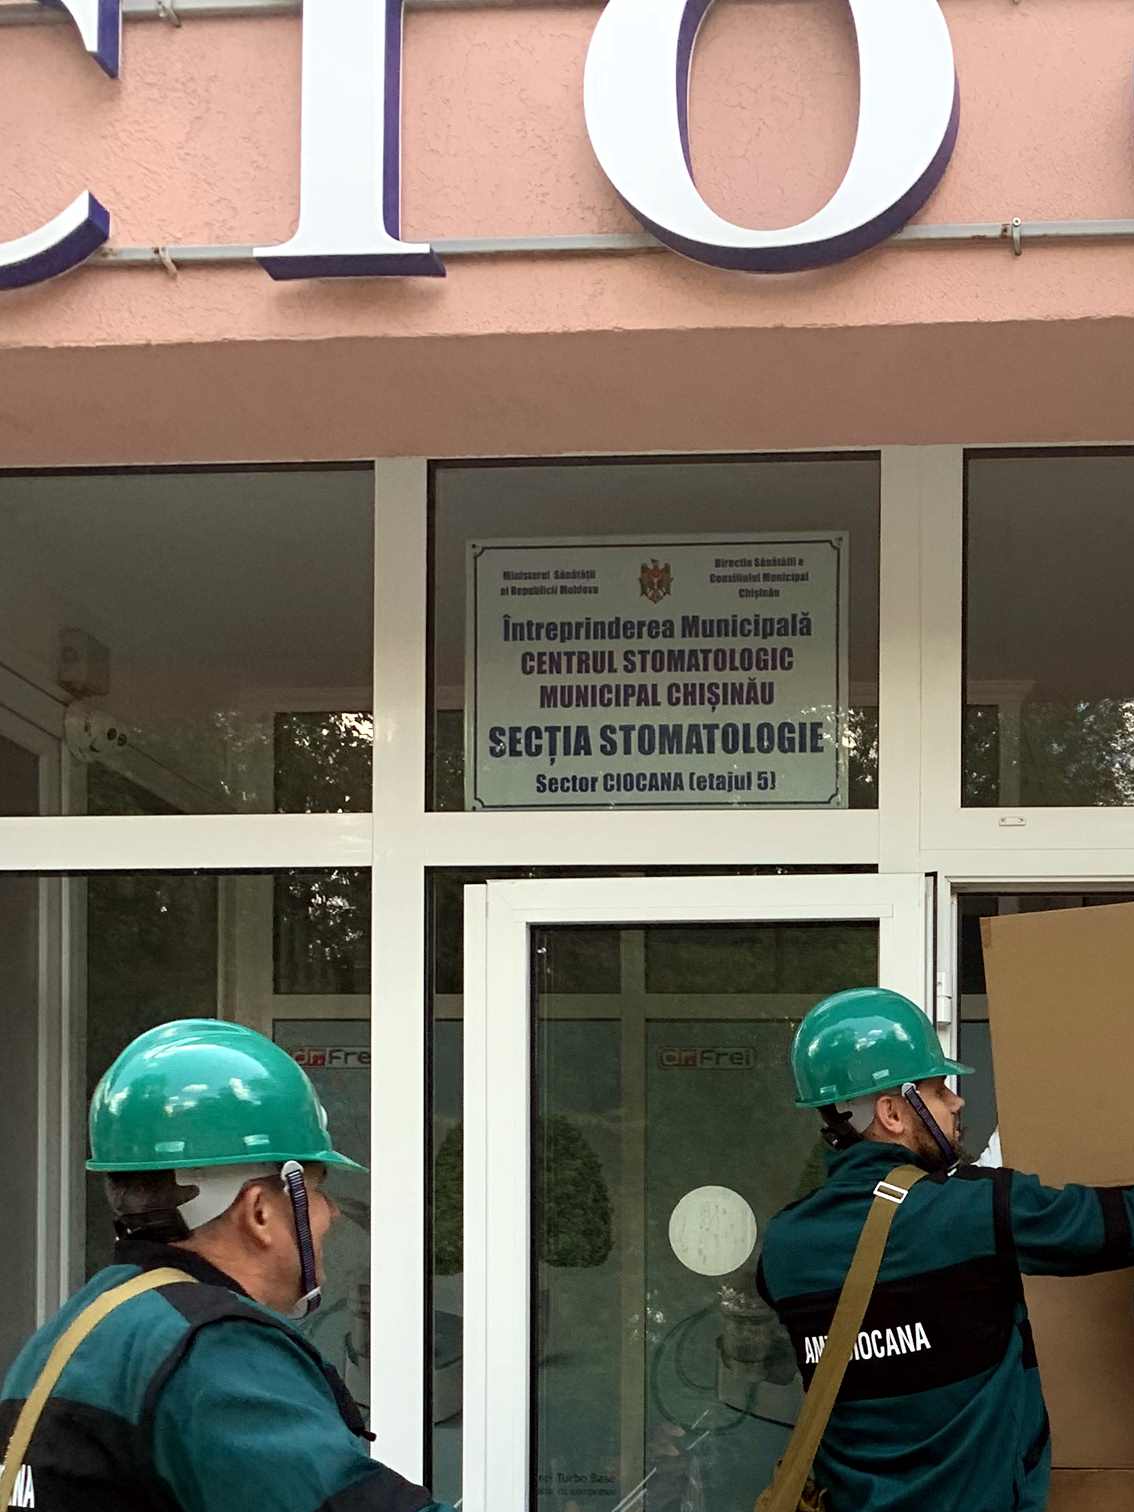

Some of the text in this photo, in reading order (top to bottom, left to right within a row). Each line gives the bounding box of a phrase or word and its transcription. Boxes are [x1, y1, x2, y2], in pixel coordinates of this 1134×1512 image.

[502, 611, 812, 643] Întreprinderea Municipală
[521, 647, 794, 675] CENTRUL STOMATOLOGIC
[540, 677, 774, 712] MUNICIPAL CHIȘINĂU
[489, 721, 824, 766] SECȚIA STOMATOLOGIE
[536, 771, 776, 793] Sector CIOCANA (etajul 5)
[849, 1321, 932, 1361] IOCANA
